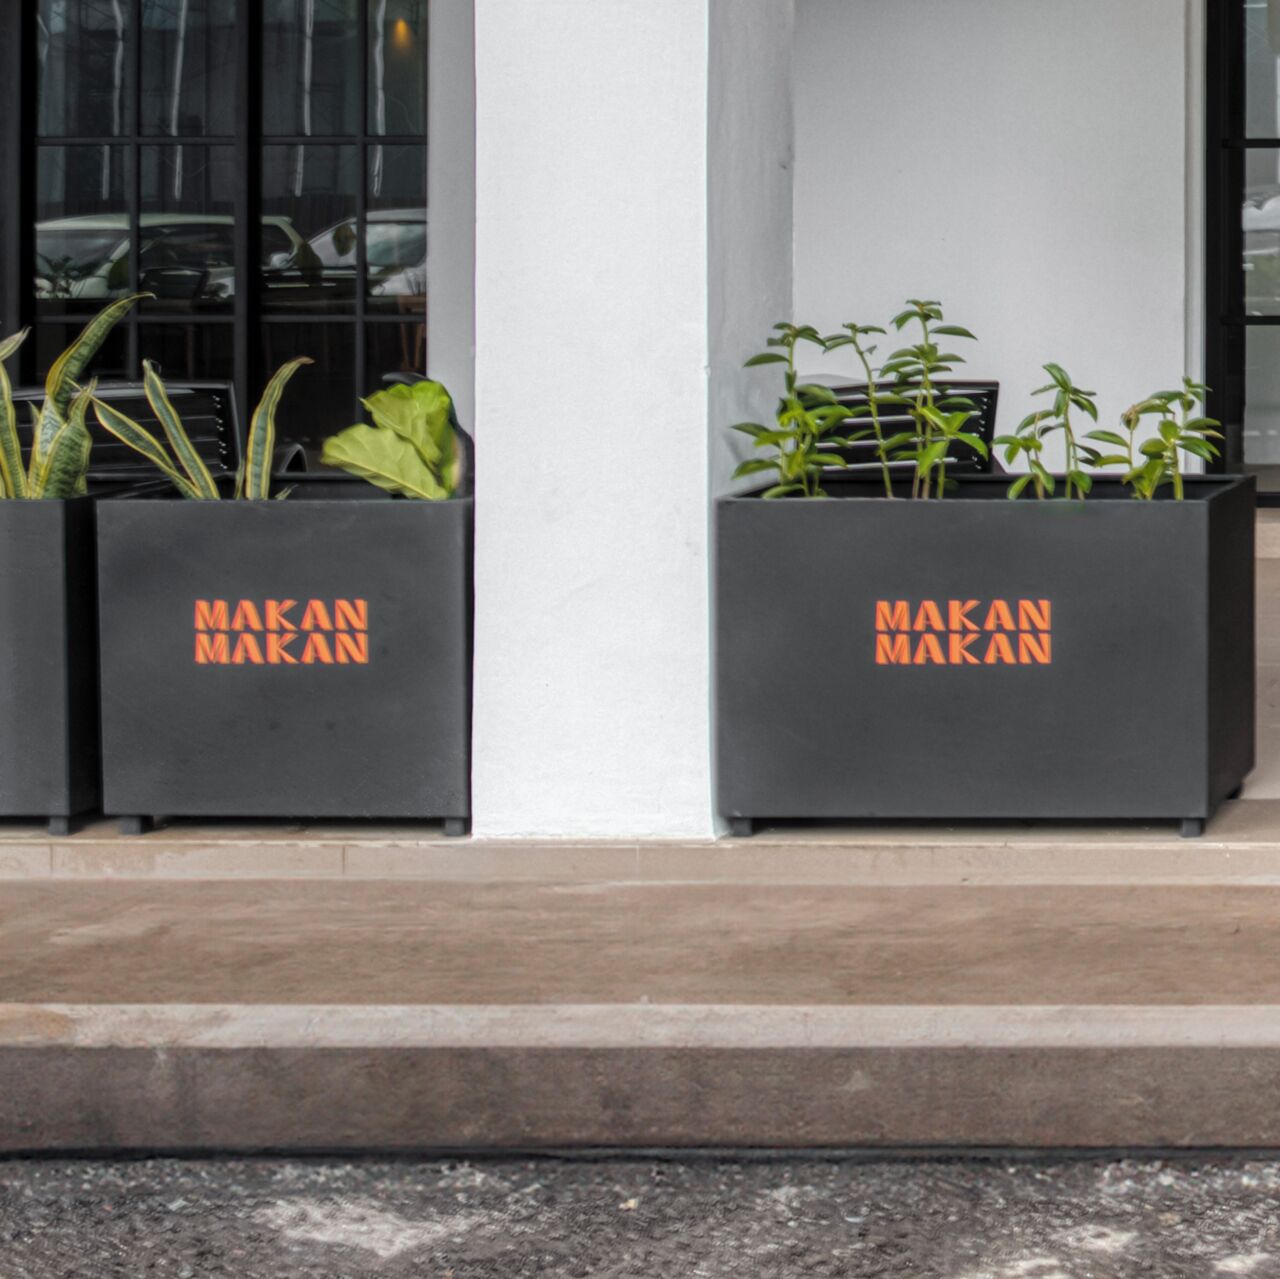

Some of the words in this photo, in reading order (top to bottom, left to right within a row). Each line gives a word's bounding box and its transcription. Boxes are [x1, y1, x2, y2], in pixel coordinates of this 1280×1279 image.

[194, 599, 368, 631] MAKAN
[874, 599, 1052, 631] MAKAN
[194, 632, 368, 664] MAKAN
[874, 632, 1052, 665] MAKAN
